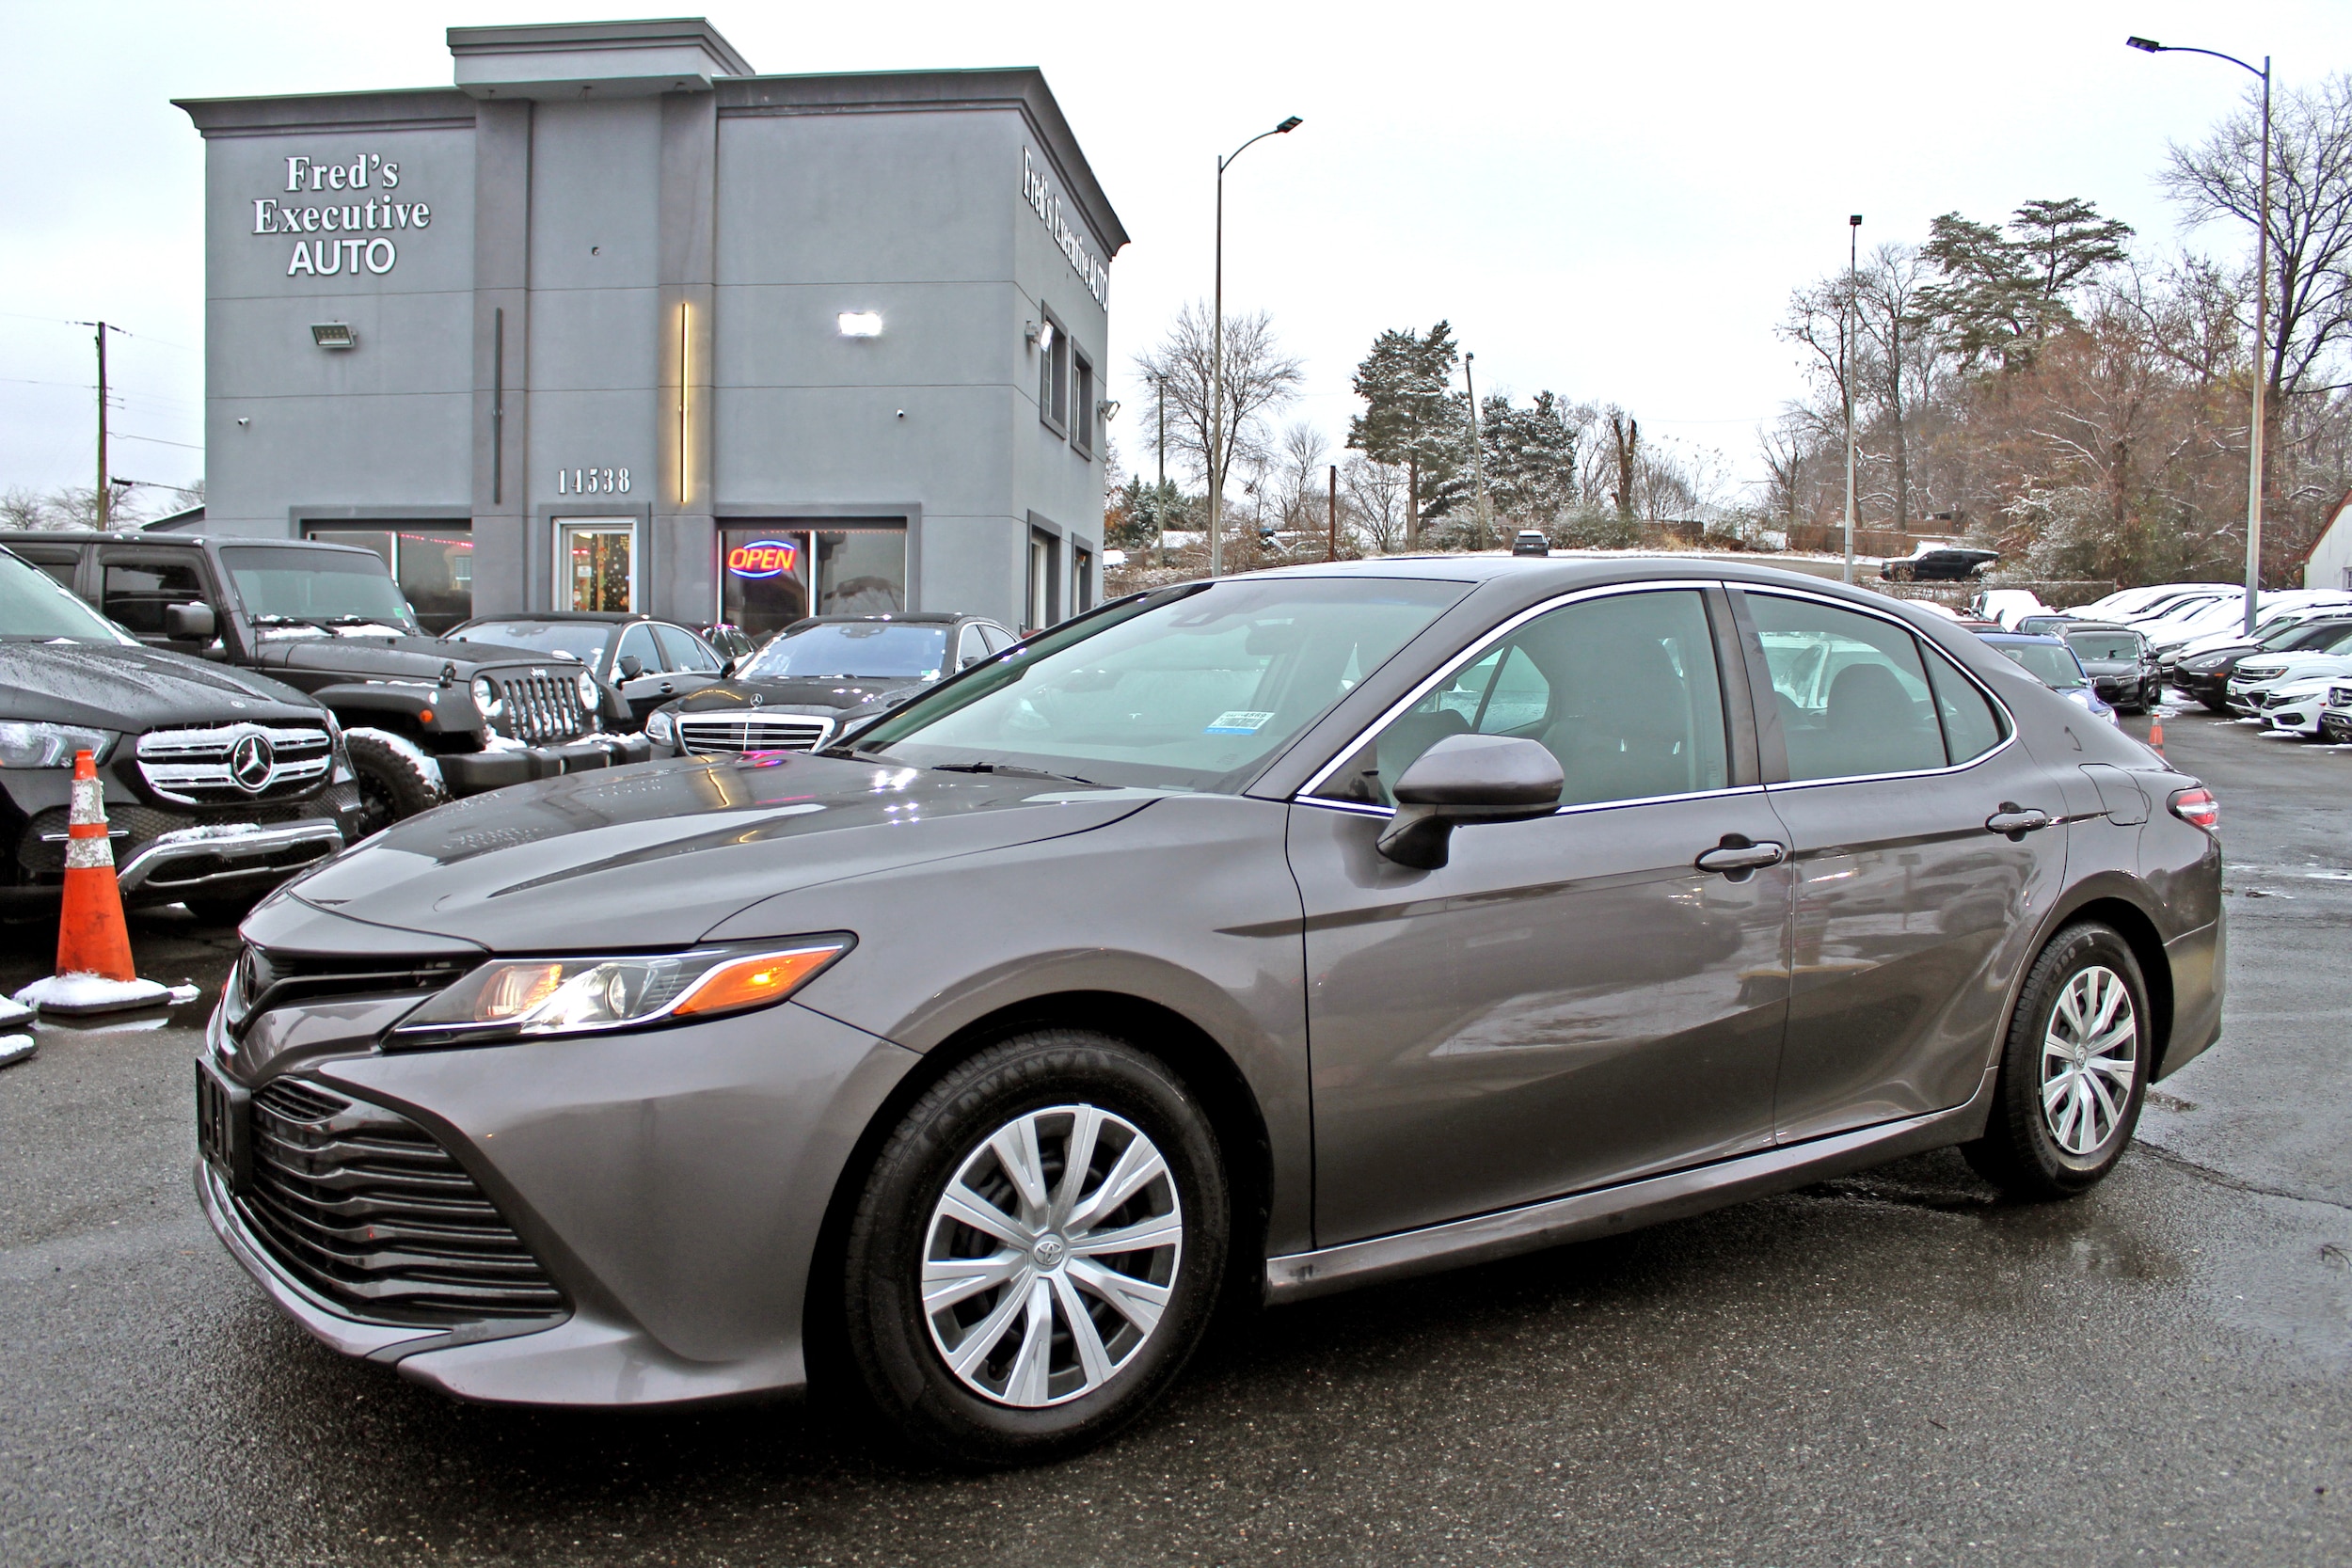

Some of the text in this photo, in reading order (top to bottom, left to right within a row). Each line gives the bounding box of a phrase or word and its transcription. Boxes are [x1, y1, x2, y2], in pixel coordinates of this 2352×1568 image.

[284, 153, 400, 192] Fred's
[252, 194, 431, 234] Executive
[1023, 146, 1109, 312] Fred's Executive AUTO
[287, 237, 397, 276] AUTO
[558, 467, 632, 494] 14538
[728, 548, 796, 571] OPEN
